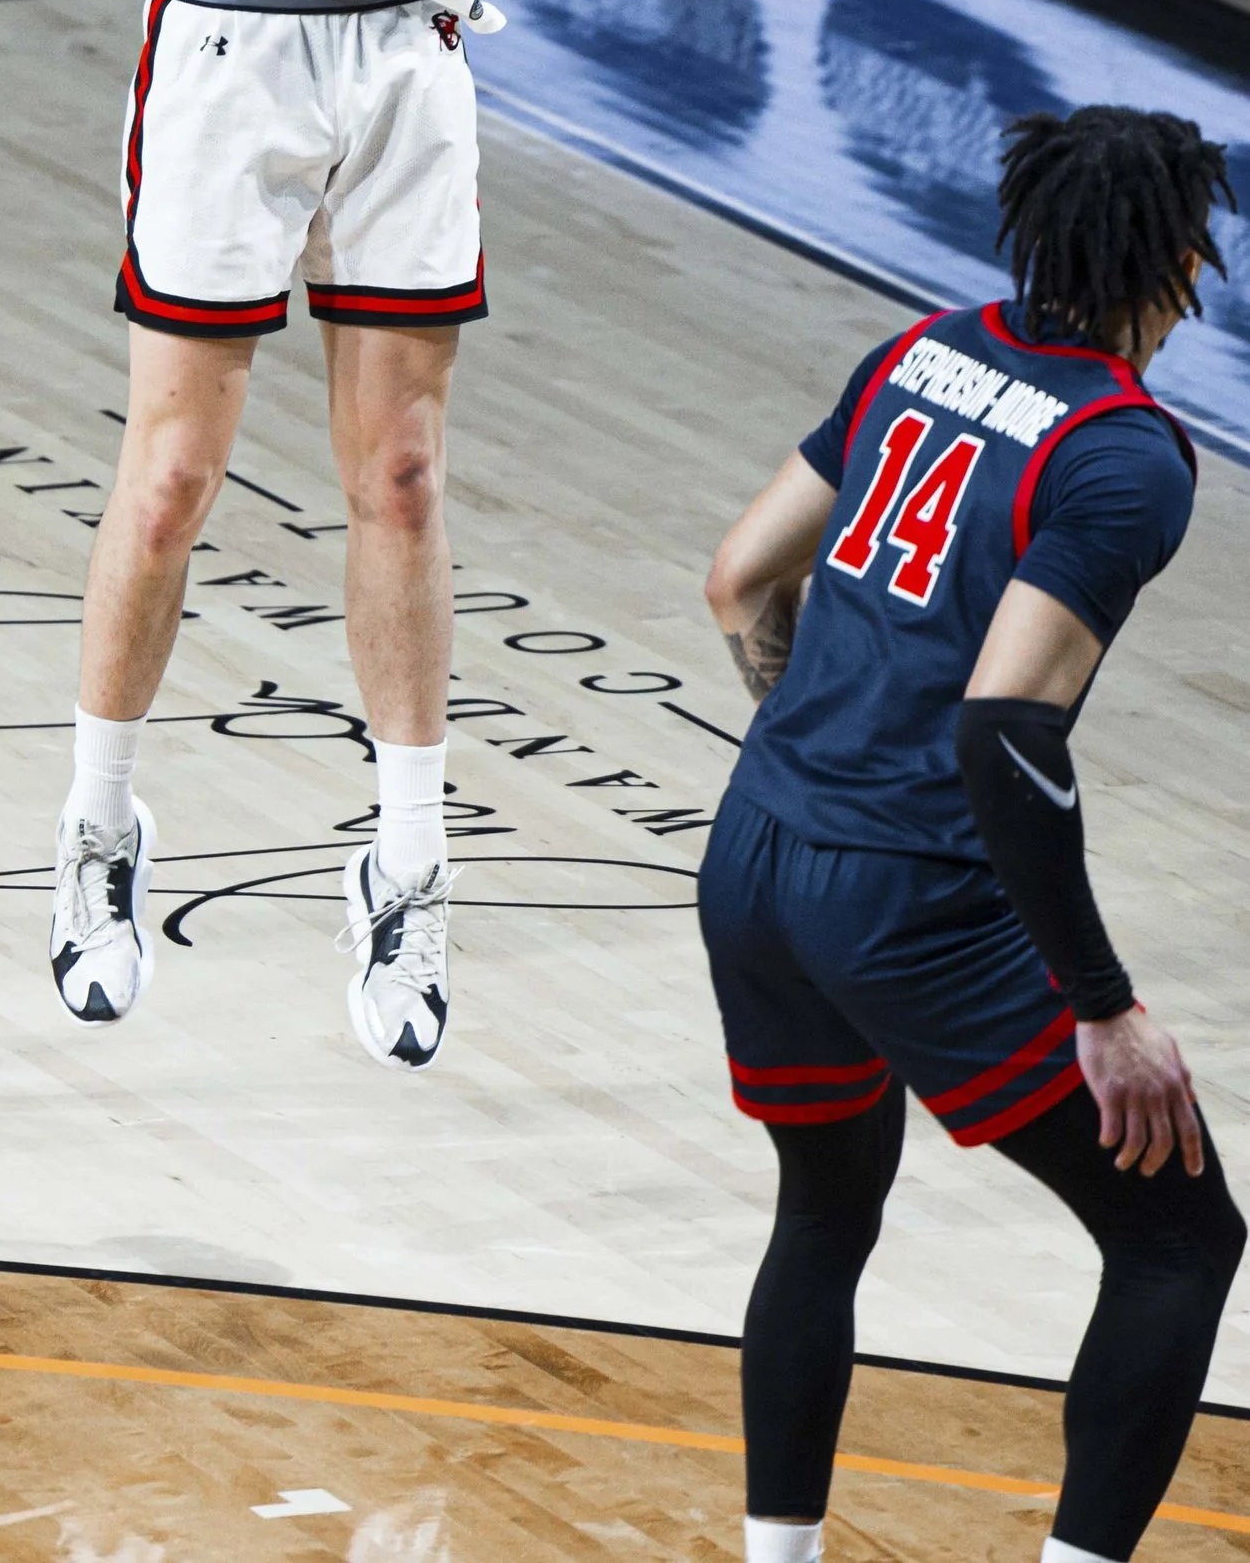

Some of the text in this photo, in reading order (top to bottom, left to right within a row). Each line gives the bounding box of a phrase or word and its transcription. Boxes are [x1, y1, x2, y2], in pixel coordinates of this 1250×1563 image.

[888, 336, 1069, 448] STEPHENSON-MOORE
[826, 408, 986, 608] 14
[277, 521, 683, 694] COUT
